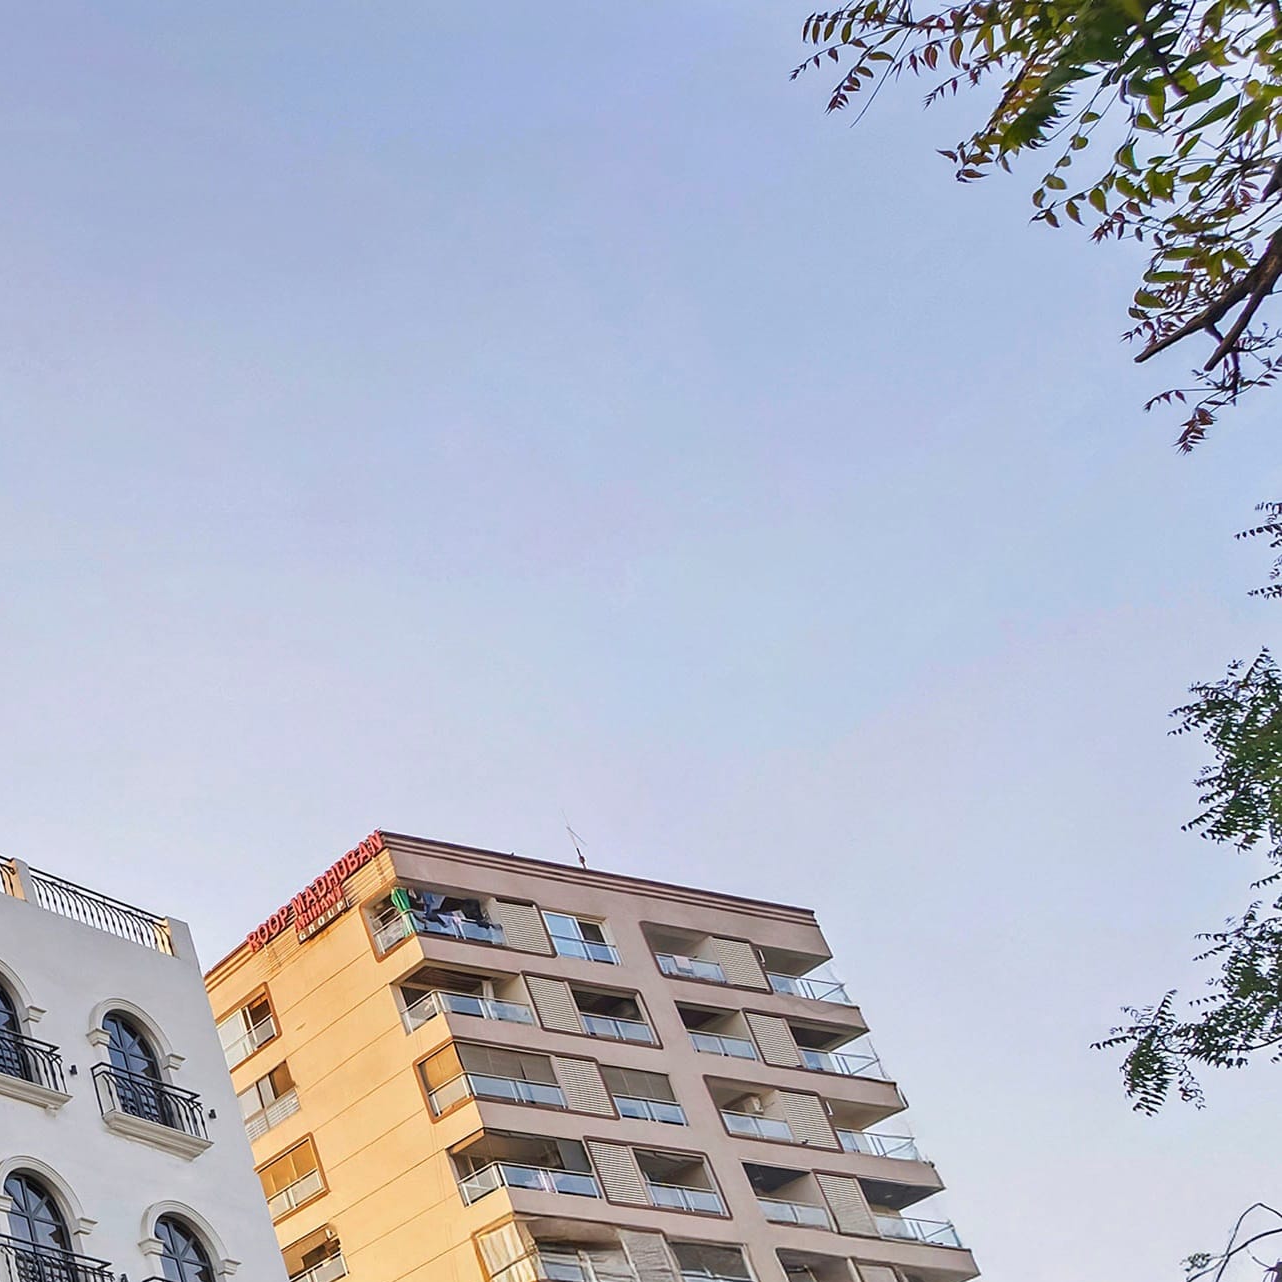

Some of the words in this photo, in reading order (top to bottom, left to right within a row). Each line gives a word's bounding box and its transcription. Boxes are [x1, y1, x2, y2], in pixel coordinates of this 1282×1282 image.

[247, 906, 289, 952] ROOP
[291, 830, 383, 915] MADHUBAN
[294, 886, 343, 932] ARIHANT
[299, 901, 344, 941] GROUP
